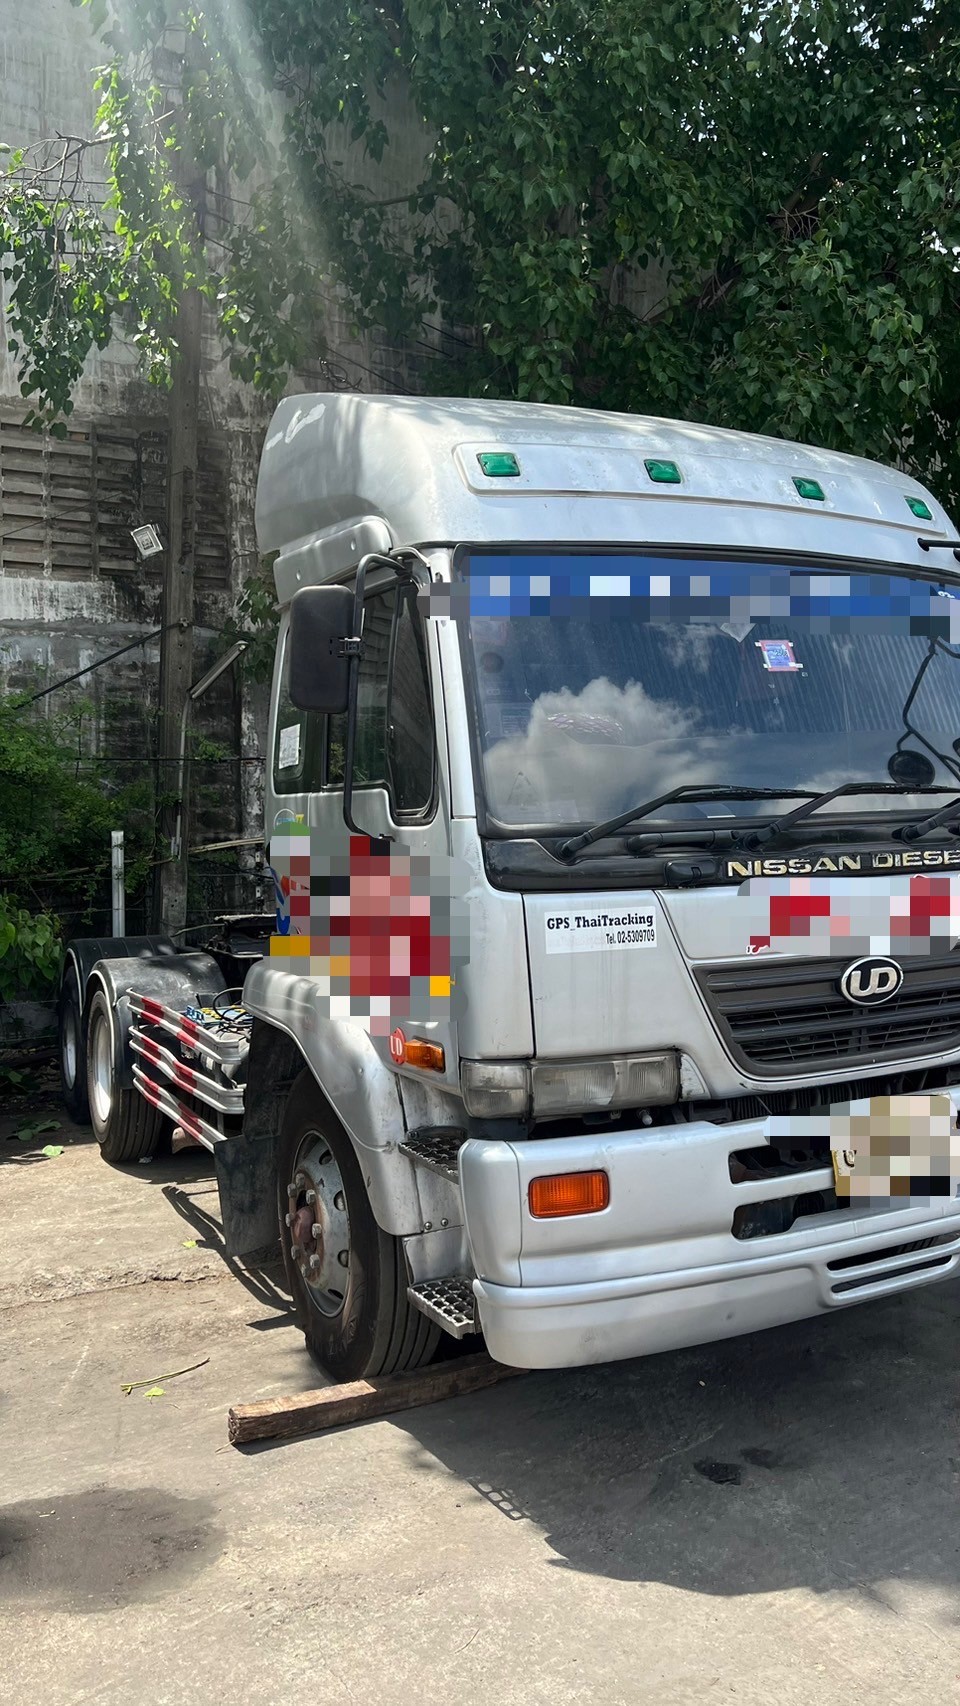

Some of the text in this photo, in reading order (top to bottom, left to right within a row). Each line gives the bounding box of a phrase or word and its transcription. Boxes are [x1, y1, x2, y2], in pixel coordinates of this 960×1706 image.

[727, 855, 861, 877] NISSAN
[547, 913, 654, 931] GPS_ThaiTracking
[606, 929, 655, 944] Tel. 02-5309709
[850, 966, 898, 997] UD
[390, 1035, 403, 1056] UD
